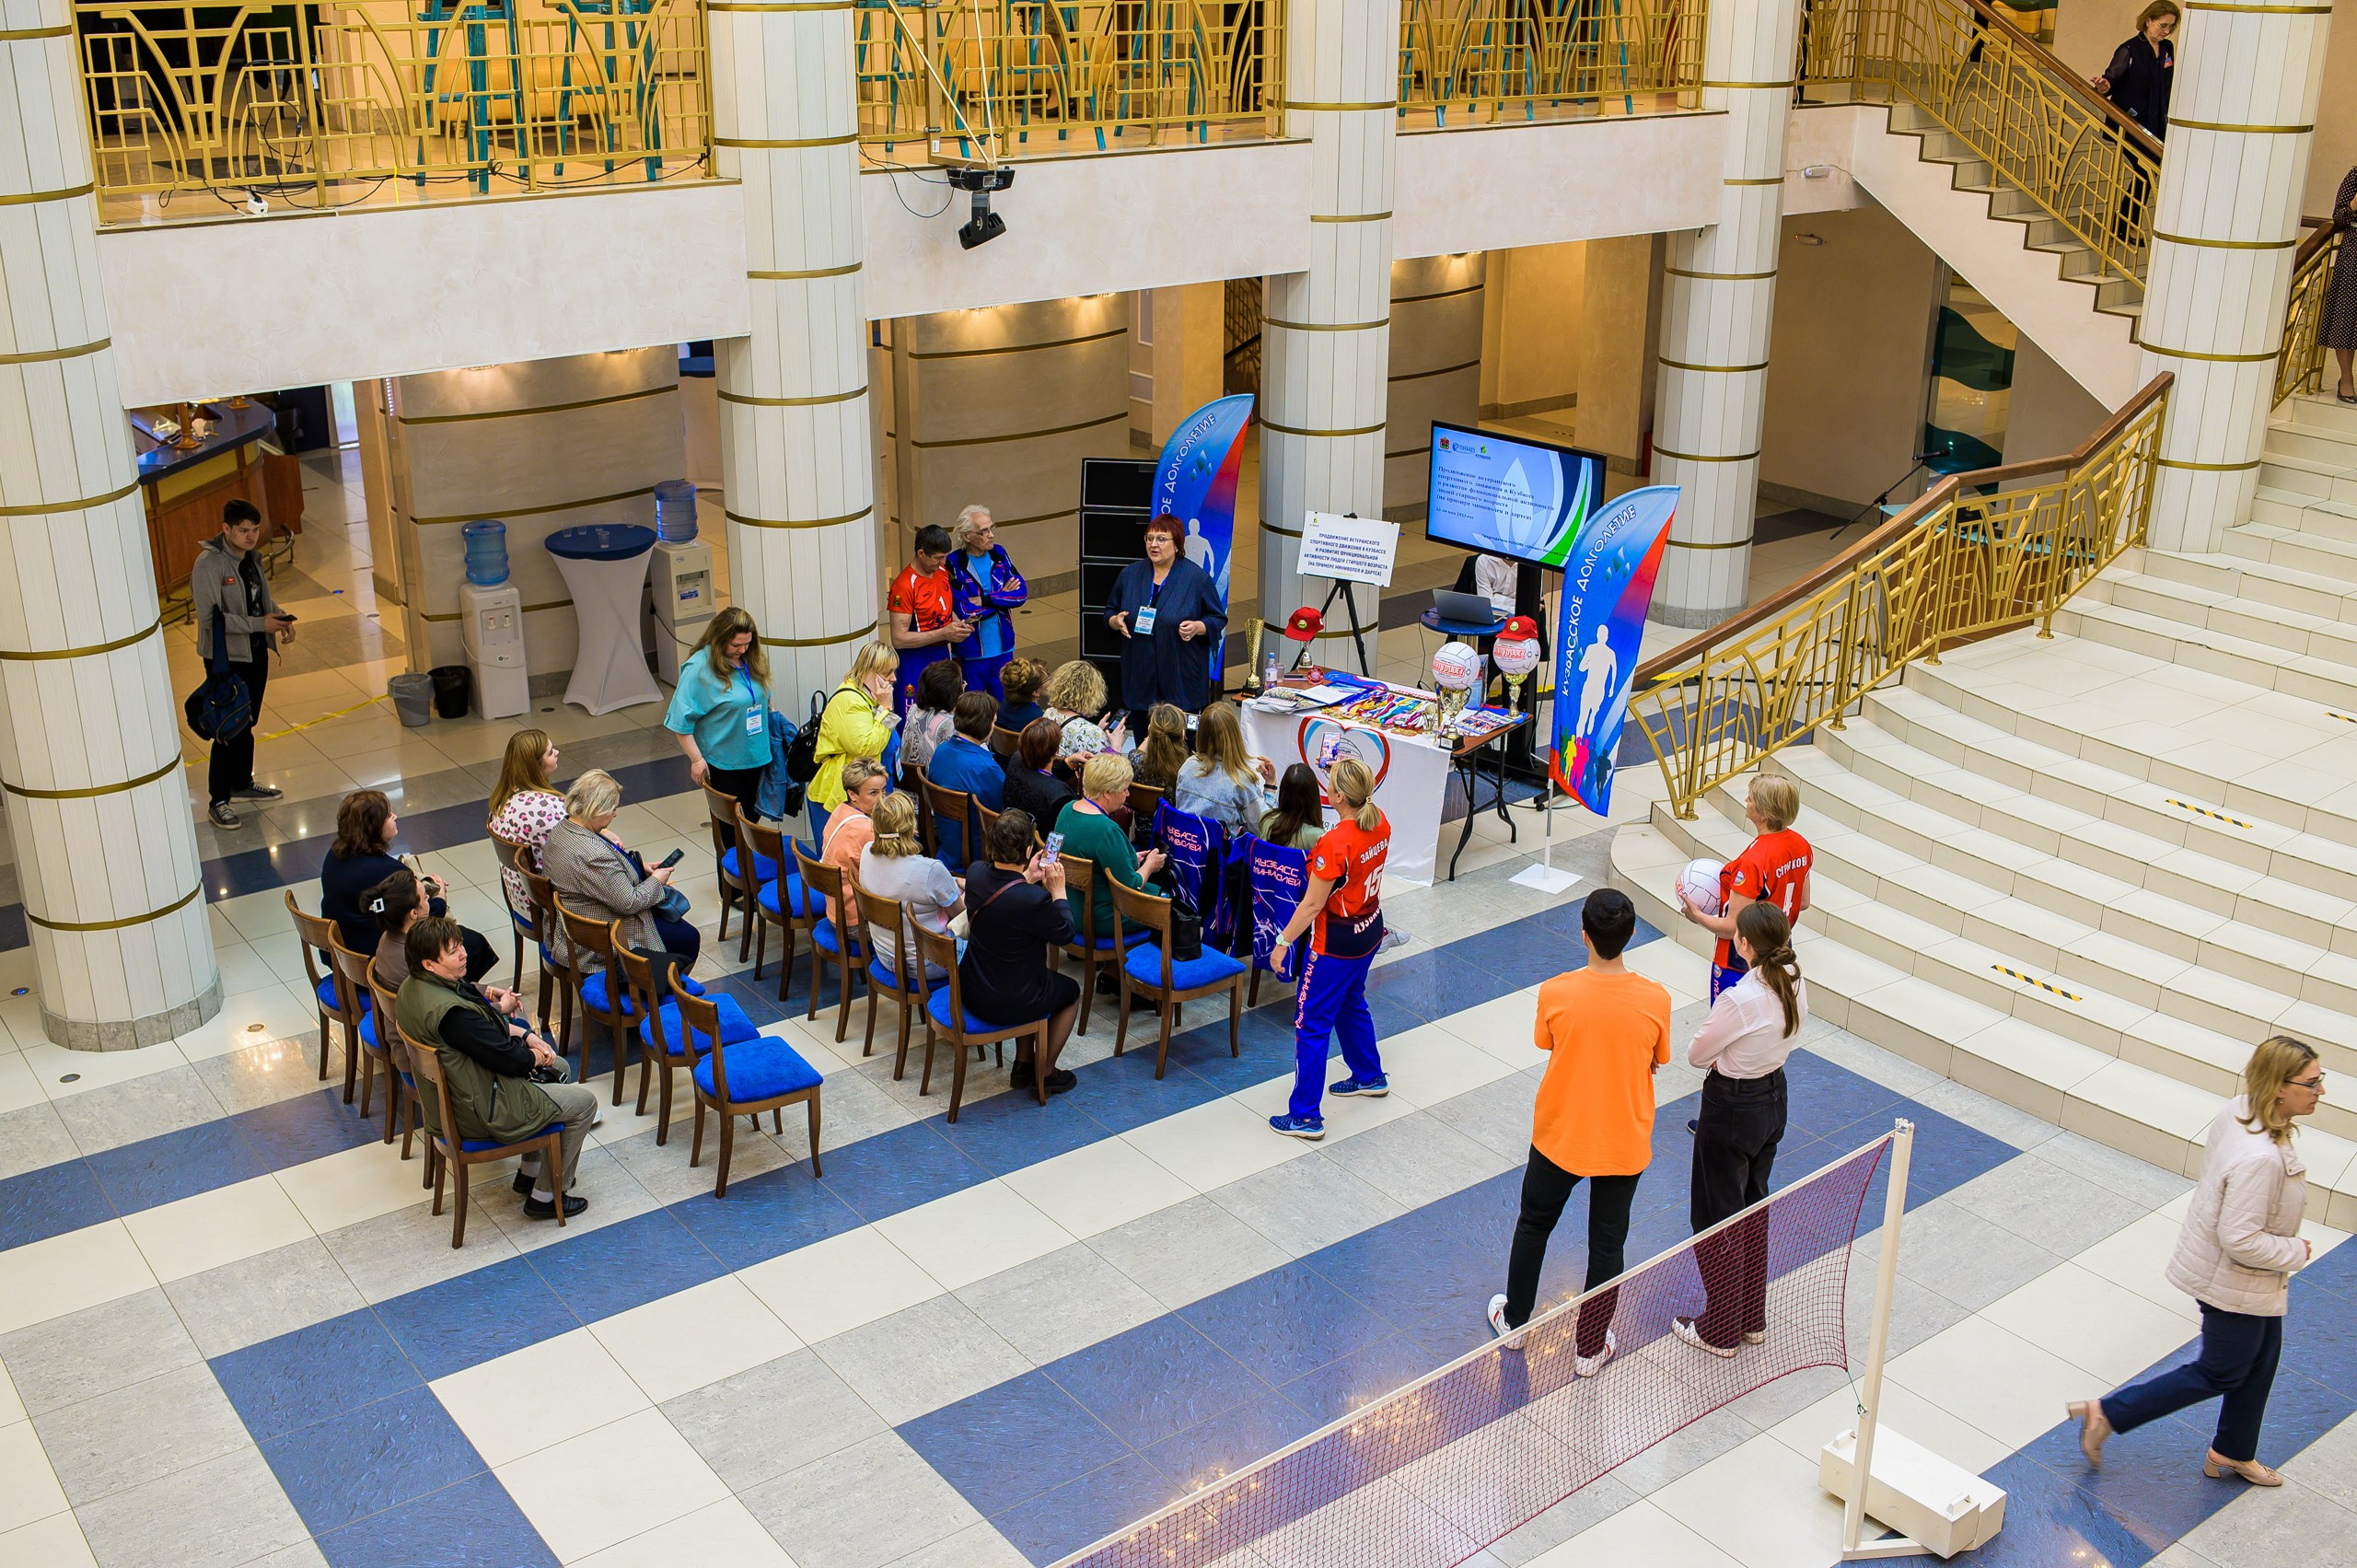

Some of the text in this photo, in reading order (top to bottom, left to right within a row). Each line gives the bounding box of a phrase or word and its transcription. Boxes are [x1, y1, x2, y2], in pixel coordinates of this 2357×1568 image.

[1165, 413, 1215, 493] ДОЛГОЛЕТИЕ
[1309, 539, 1338, 548] СПОРТИВНОГО
[1318, 533, 1380, 546] ПРОДВИЖЕНИЕ ВЕТЕРАНСКОГО
[1340, 551, 1378, 560] ФУНКЦИОНАЛЬНОЙ
[1346, 559, 1367, 567] СТАРШЕГО
[939, 596, 946, 610] 1
[1562, 505, 1636, 697] КУЗБАССКОЕ ДОЛГОЛЕТИЕ
[1360, 838, 1388, 864] ЗАЙЦЕВА
[1252, 866, 1301, 888] МИНИОЛЕЙ
[1254, 856, 1299, 877] КУЗБАСС
[1364, 863, 1384, 904] 15
